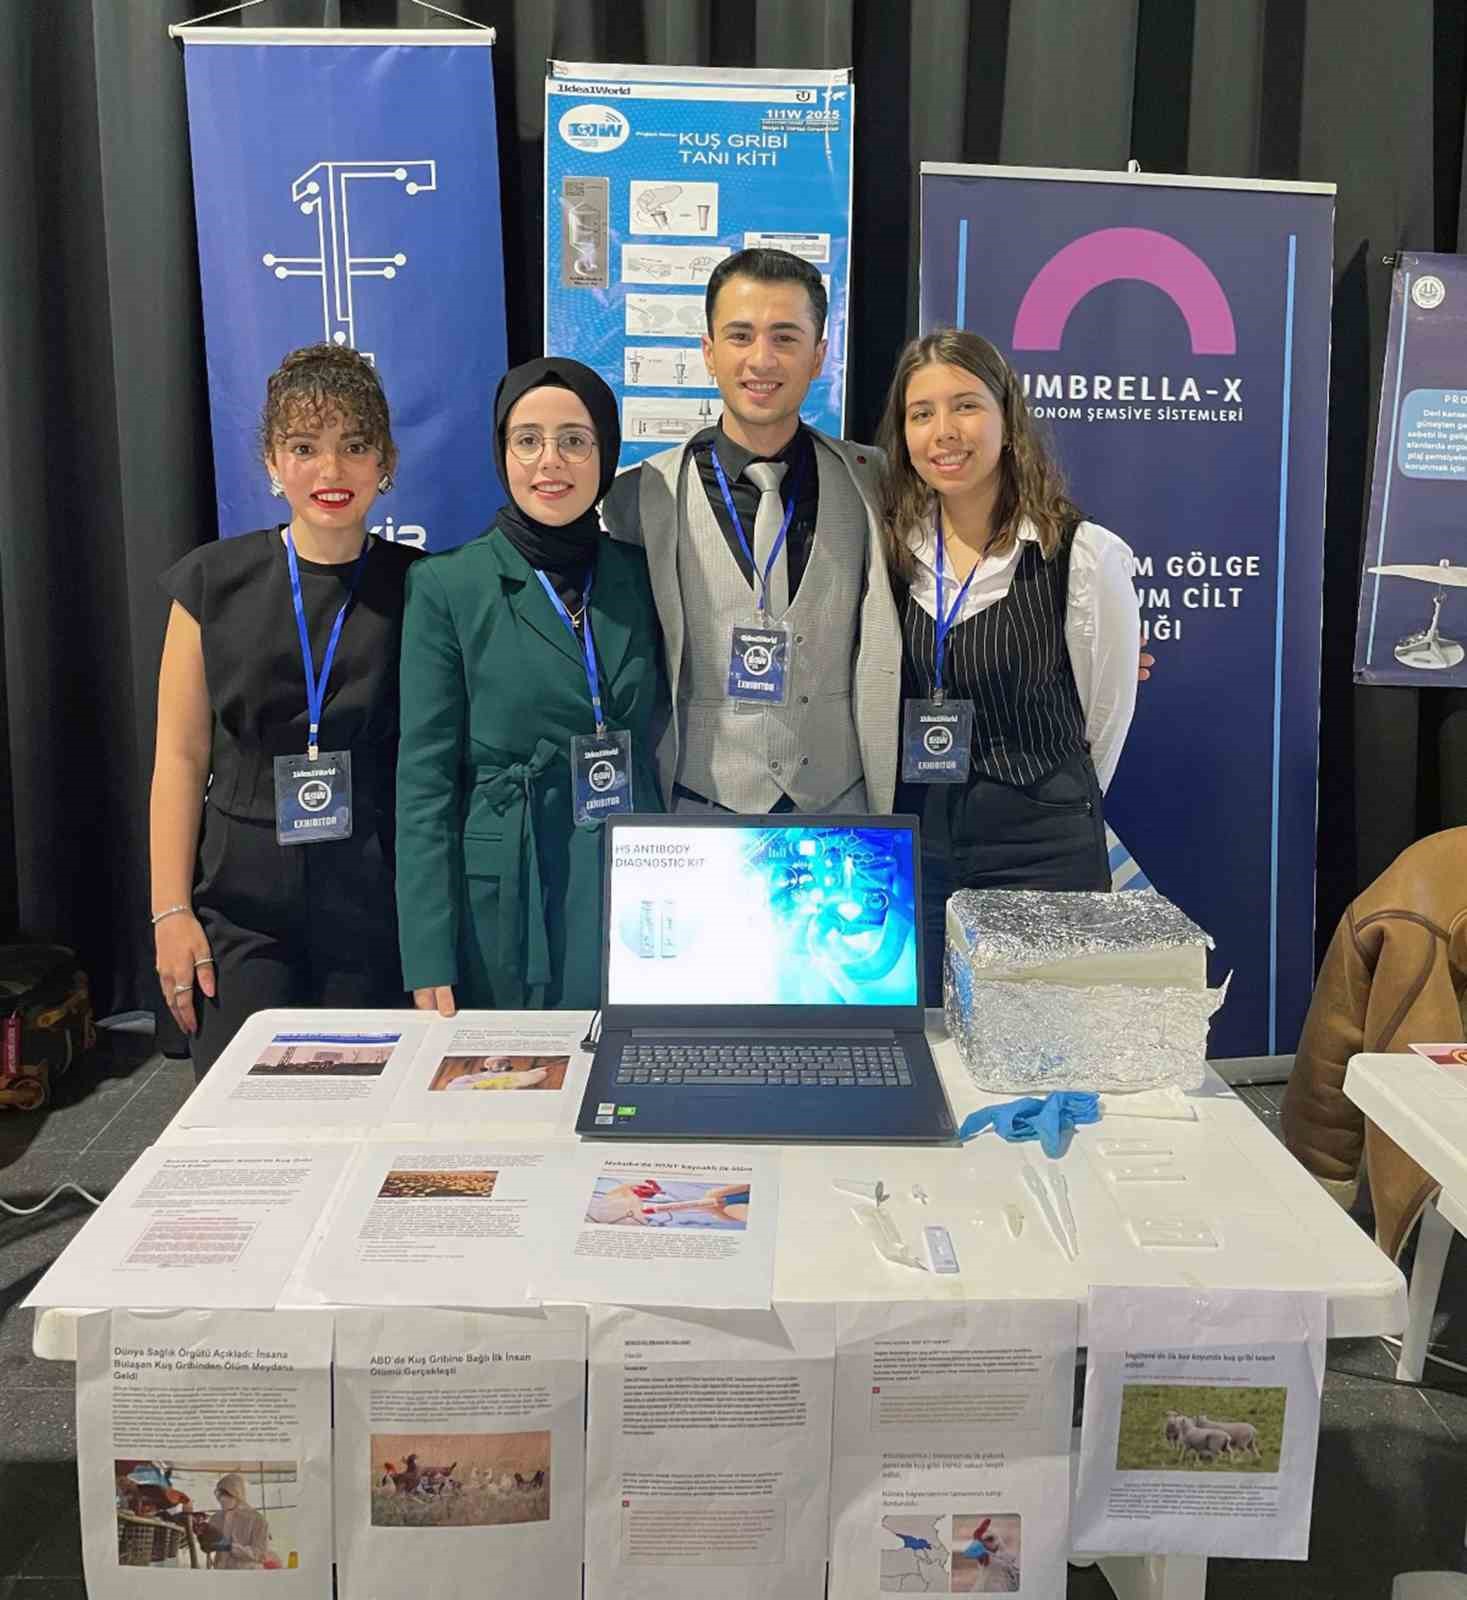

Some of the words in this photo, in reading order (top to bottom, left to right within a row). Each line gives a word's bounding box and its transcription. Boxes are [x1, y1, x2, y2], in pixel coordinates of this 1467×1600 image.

[806, 110, 840, 119] 2025
[679, 133, 720, 150] KUŞ
[728, 131, 788, 149] GRİBİ
[679, 151, 728, 165] TANI
[736, 149, 777, 166] KİTİ
[1088, 406, 1152, 421] ŞEMSİYE
[1157, 405, 1243, 421] SİSTEMLERİ
[1166, 551, 1260, 577] GÖLGE
[1183, 583, 1243, 609] CİLT
[634, 844, 690, 854] ANTIBODY
[615, 858, 686, 868] DIAGNOSTIC
[688, 858, 704, 868] KIT
[113, 1346, 144, 1358] Dünya
[147, 1346, 176, 1359] Sağlık
[178, 1346, 212, 1360] Örgütü
[256, 1348, 288, 1359] İnsana
[408, 1355, 426, 1366] Kuş
[466, 1353, 490, 1364] Bağlı
[505, 1351, 531, 1361] İnsan
[114, 1360, 152, 1370] Bulaşan
[154, 1360, 172, 1371] Kuş
[175, 1361, 221, 1371] Gribinden
[224, 1361, 249, 1371] Ölüm
[252, 1363, 294, 1374] Meydana
[404, 1366, 456, 1377] Gerçekleşti
[113, 1371, 138, 1380] Geldi
